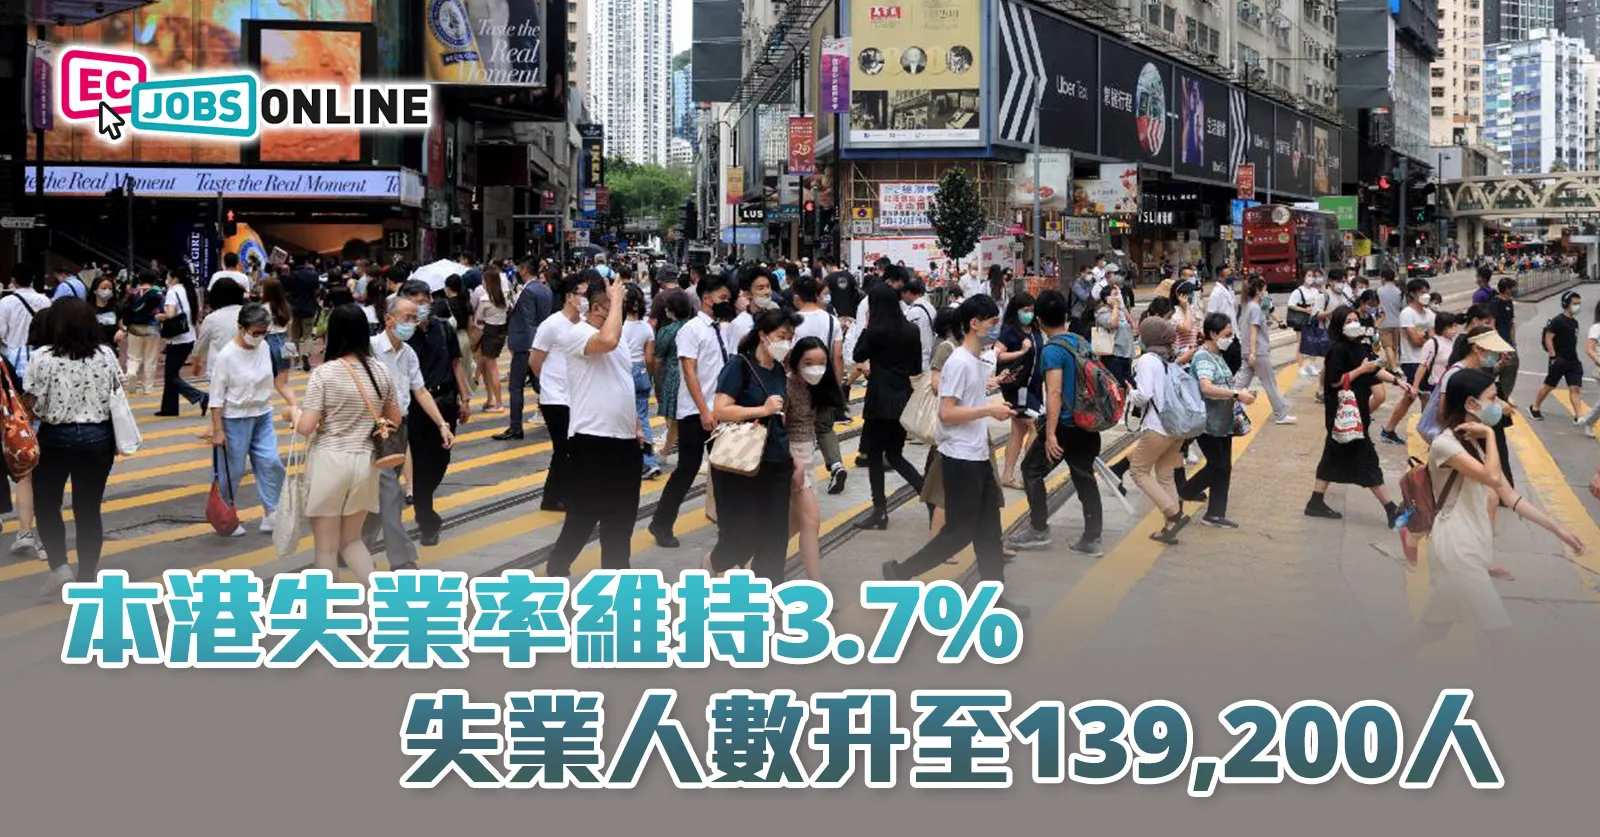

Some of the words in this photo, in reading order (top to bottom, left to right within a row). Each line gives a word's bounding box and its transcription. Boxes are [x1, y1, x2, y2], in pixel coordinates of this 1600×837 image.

[478, 19, 516, 36] Taste
[517, 19, 541, 37] the
[490, 39, 541, 63] Real
[1056, 74, 1075, 96] Uber
[69, 171, 109, 189] Real
[196, 172, 236, 191] Taste
[238, 173, 263, 191] the
[264, 174, 301, 192] Real
[302, 175, 367, 193] Moment
